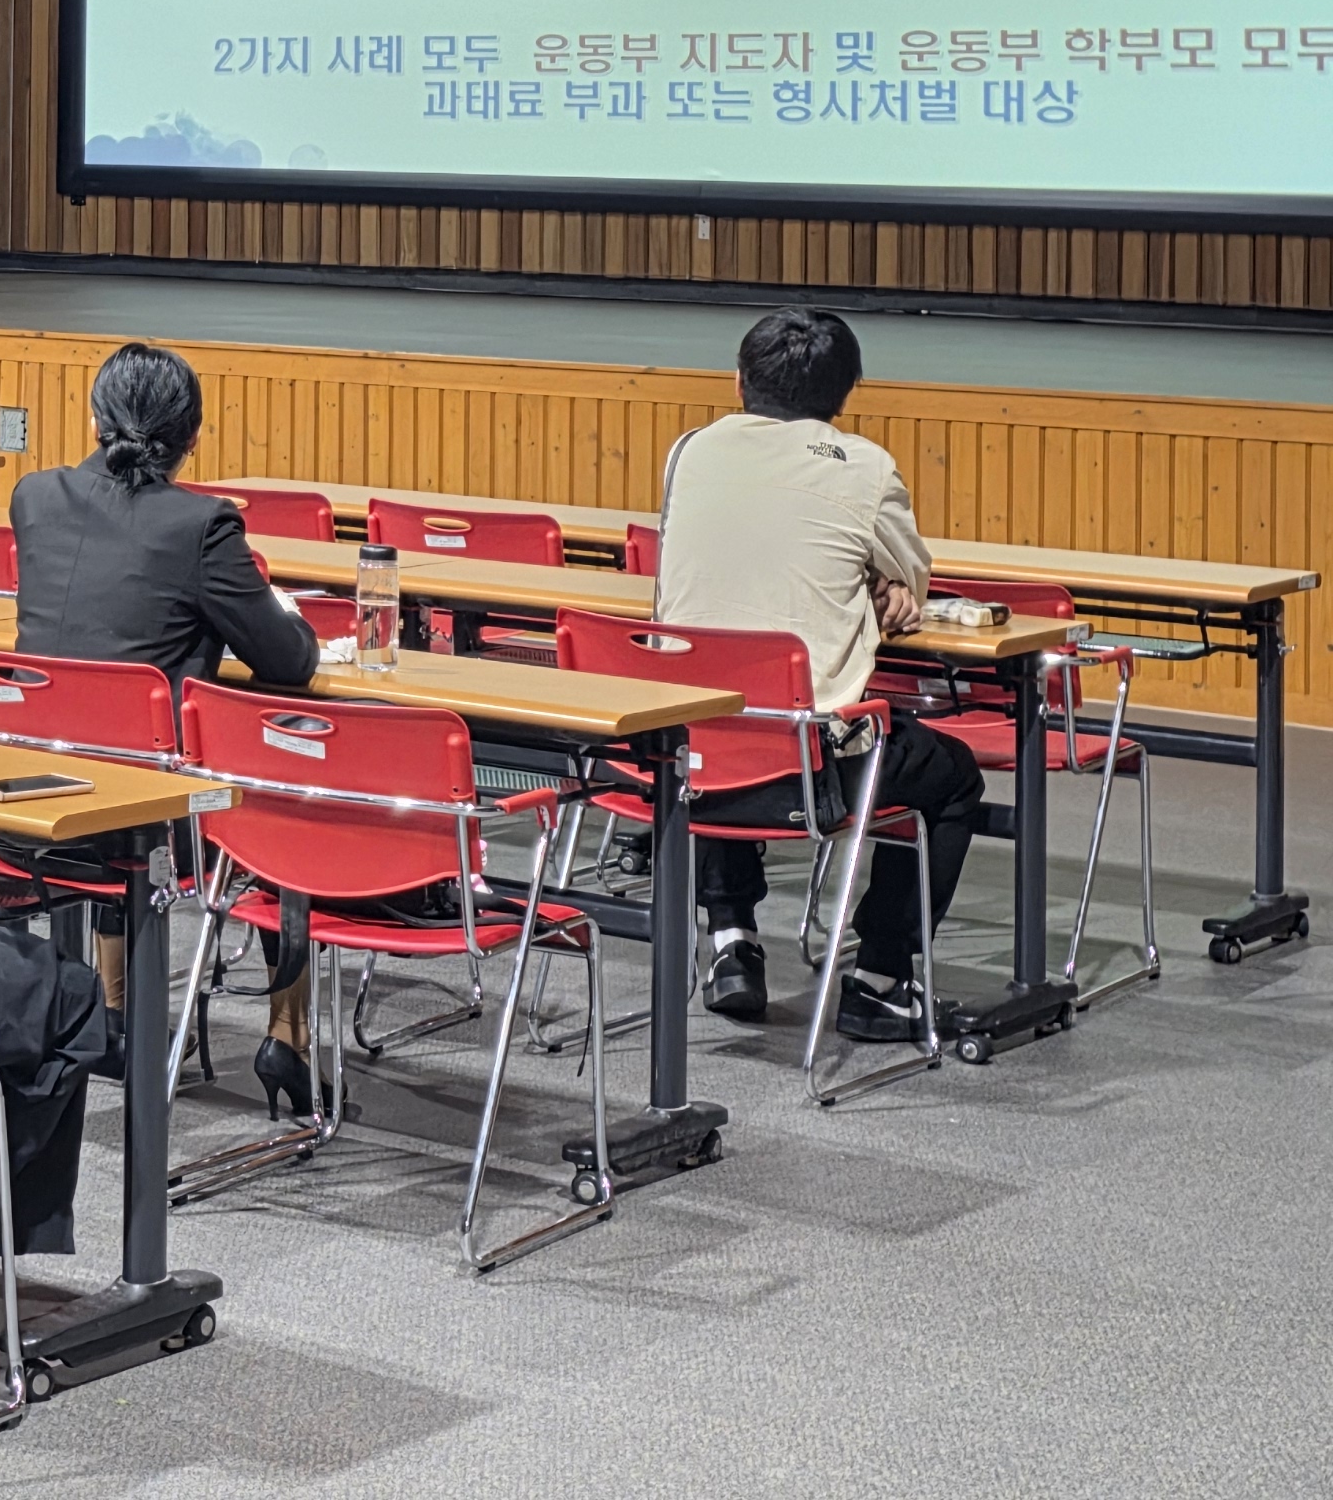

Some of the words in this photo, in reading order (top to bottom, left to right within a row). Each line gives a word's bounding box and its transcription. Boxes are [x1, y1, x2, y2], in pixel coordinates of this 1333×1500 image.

[214, 36, 310, 74] 2가지
[327, 36, 404, 74] 사례
[422, 36, 501, 74] 모두
[533, 33, 660, 75] 운동부
[680, 32, 814, 74] 지도자
[834, 30, 876, 73] 및
[898, 29, 1042, 73] 운동부
[1064, 27, 1217, 72] 학부모
[1241, 27, 1333, 72] 모두
[423, 80, 545, 121] 과태료
[563, 80, 647, 121] 부과
[666, 80, 752, 122] 또는
[773, 79, 959, 124] 형사처벌
[982, 78, 1079, 124] 대상
